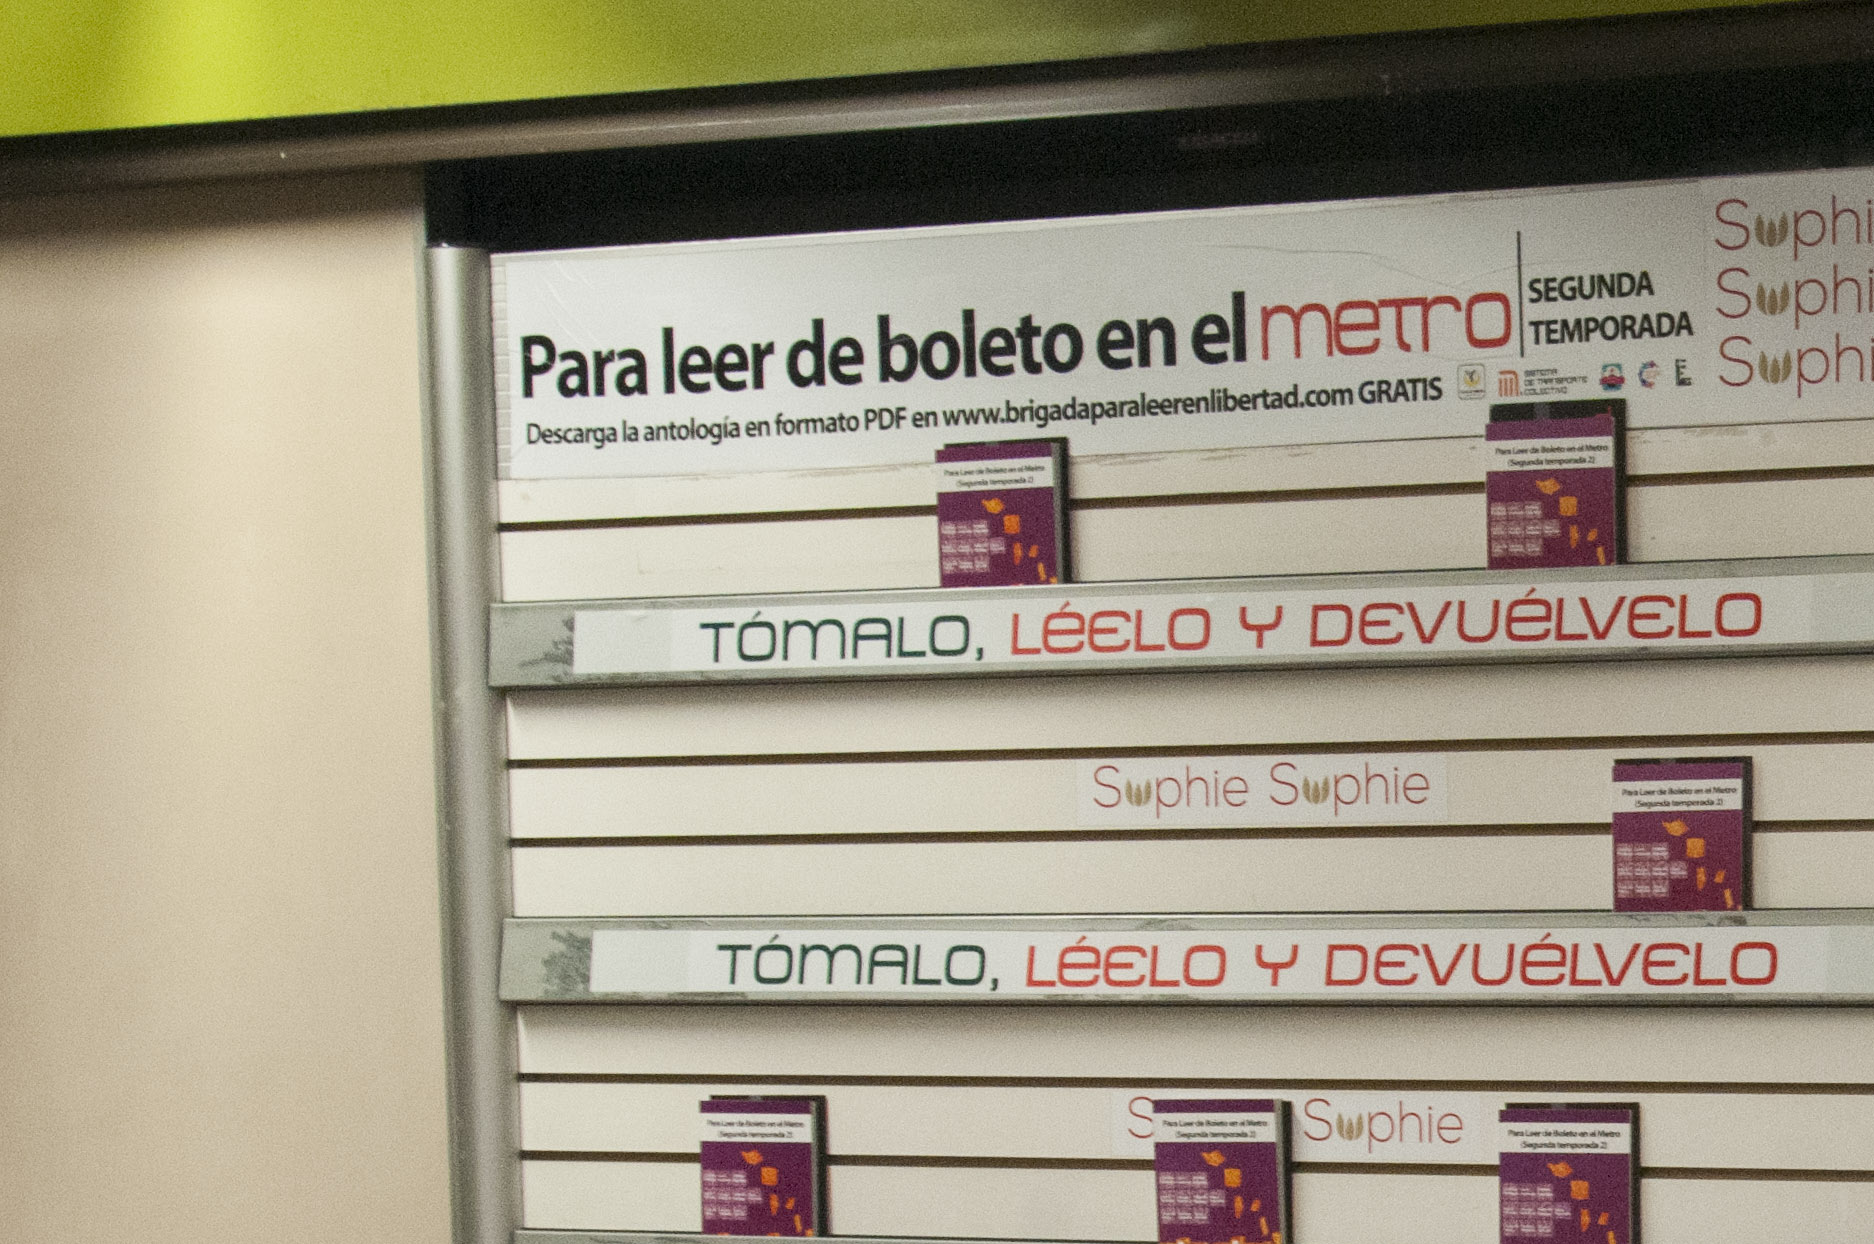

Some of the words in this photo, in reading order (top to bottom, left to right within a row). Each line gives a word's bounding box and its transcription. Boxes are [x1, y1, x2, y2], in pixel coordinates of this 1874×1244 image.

[1529, 271, 1654, 303] SEGUNDA
[522, 336, 647, 398] Para
[664, 328, 774, 394] leer
[788, 319, 864, 388] de
[879, 309, 1083, 382] boleto
[1097, 317, 1176, 370] en
[1192, 291, 1246, 364] el
[1529, 311, 1694, 344] TEMPORADA
[528, 423, 617, 449] Descarga
[623, 421, 639, 442] la
[644, 418, 740, 445] antología
[745, 421, 770, 437] en
[775, 413, 860, 435] formato
[865, 407, 906, 430] PDF
[912, 411, 938, 428] en
[943, 384, 1354, 428] www.brigadaparaleerenlibertad.com
[1359, 377, 1443, 404] GRATIS
[700, 611, 985, 662] TÓMALO,
[1012, 602, 1211, 655] LÉELO
[1240, 606, 1283, 648] Y
[1311, 588, 1762, 646] DEVUÉLVELO
[717, 935, 999, 992] TÓMALO,
[1027, 937, 1226, 987] LÉELO
[1256, 945, 1298, 986] Y
[1326, 933, 1777, 986] DEVUÉLVELO
